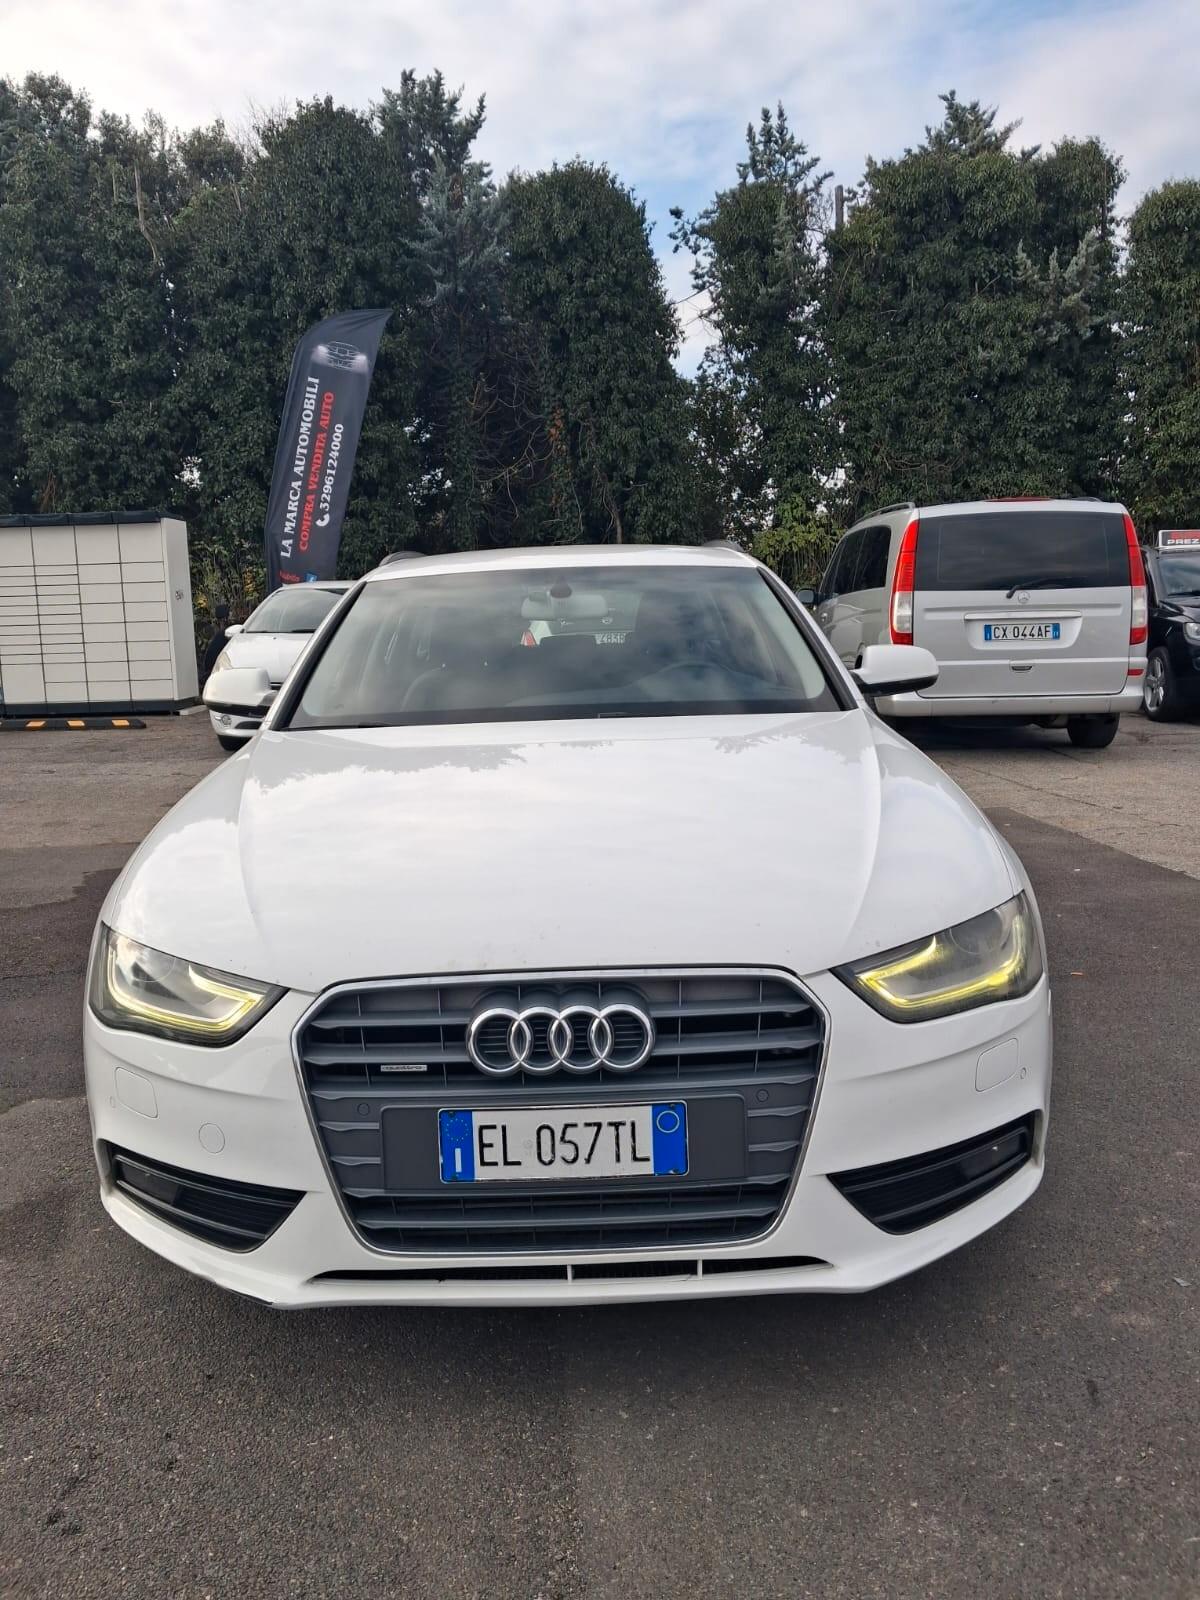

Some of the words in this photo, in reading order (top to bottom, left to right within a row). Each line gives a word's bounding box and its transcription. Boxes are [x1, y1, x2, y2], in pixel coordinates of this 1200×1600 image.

[293, 376, 320, 477] AUTOMOBILI
[300, 494, 315, 551] COMPRA
[308, 432, 327, 490] VENDITA
[319, 391, 334, 432] AUTO
[319, 423, 344, 512] 3296124000
[284, 480, 302, 534] MARCA
[280, 539, 293, 558] LA
[993, 626, 1008, 639] CX
[1012, 625, 1051, 638] 044AF
[477, 1124, 522, 1167] EL
[535, 1120, 651, 1166] 057TL
